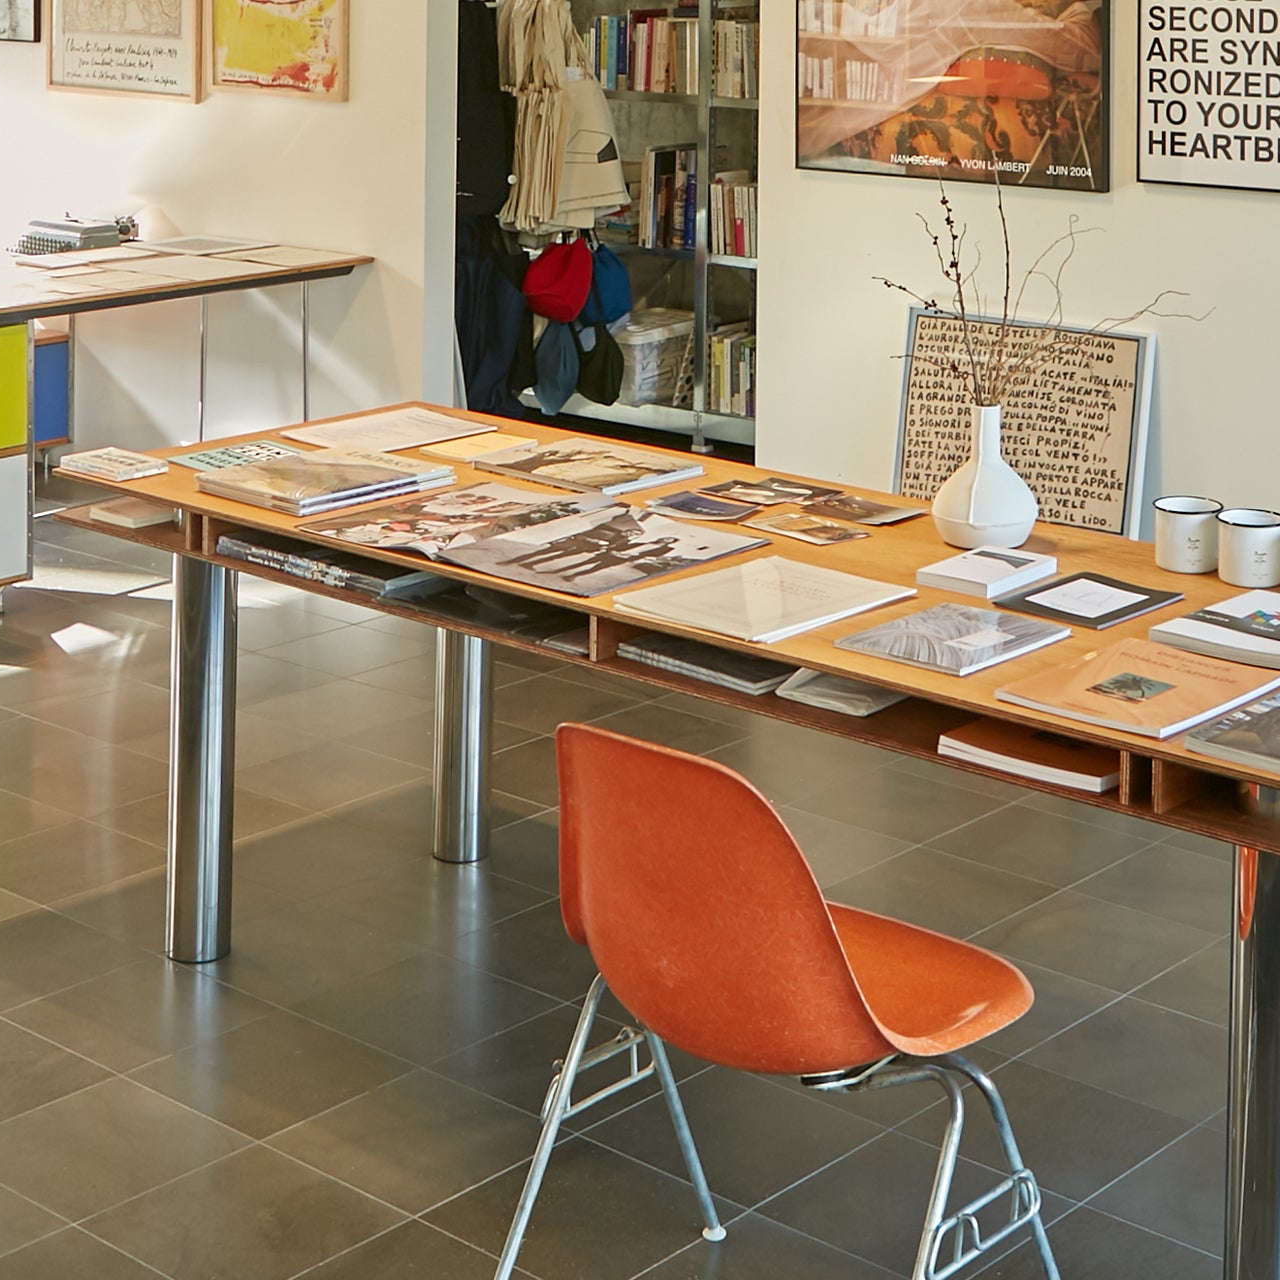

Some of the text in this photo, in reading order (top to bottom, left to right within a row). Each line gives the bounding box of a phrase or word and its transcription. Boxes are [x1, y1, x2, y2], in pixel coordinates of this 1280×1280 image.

[1146, 37, 1209, 64] ARE
[1147, 99, 1187, 125] TO
[890, 154, 908, 165] NAN
[960, 158, 986, 170] YVON
[987, 160, 1031, 172] LAMBERT
[1046, 165, 1069, 176] JUIN
[1070, 166, 1093, 177] 2004
[911, 380, 952, 391] ALLORA
[1060, 396, 1117, 411] CORONATA
[925, 392, 966, 404] GRANDE
[1059, 405, 1069, 415] DI
[1076, 409, 1104, 420] VINO
[1003, 411, 1033, 421] SULLA
[909, 419, 916, 427] O
[919, 417, 961, 429] SIGNORI
[1058, 428, 1095, 442] TERRA
[915, 428, 931, 438] DEI
[907, 439, 933, 449] FATE
[937, 441, 950, 452] LA
[1022, 448, 1041, 457] COL
[907, 450, 963, 464] SOFFIANO
[1024, 459, 1080, 474] INVOCATE
[905, 472, 920, 481] UN
[1041, 484, 1071, 496] SULLA
[1036, 472, 1069, 484] PORTO
[1081, 477, 1124, 491] APPARE
[1055, 498, 1086, 510] VELE
[1064, 511, 1076, 522] IL
